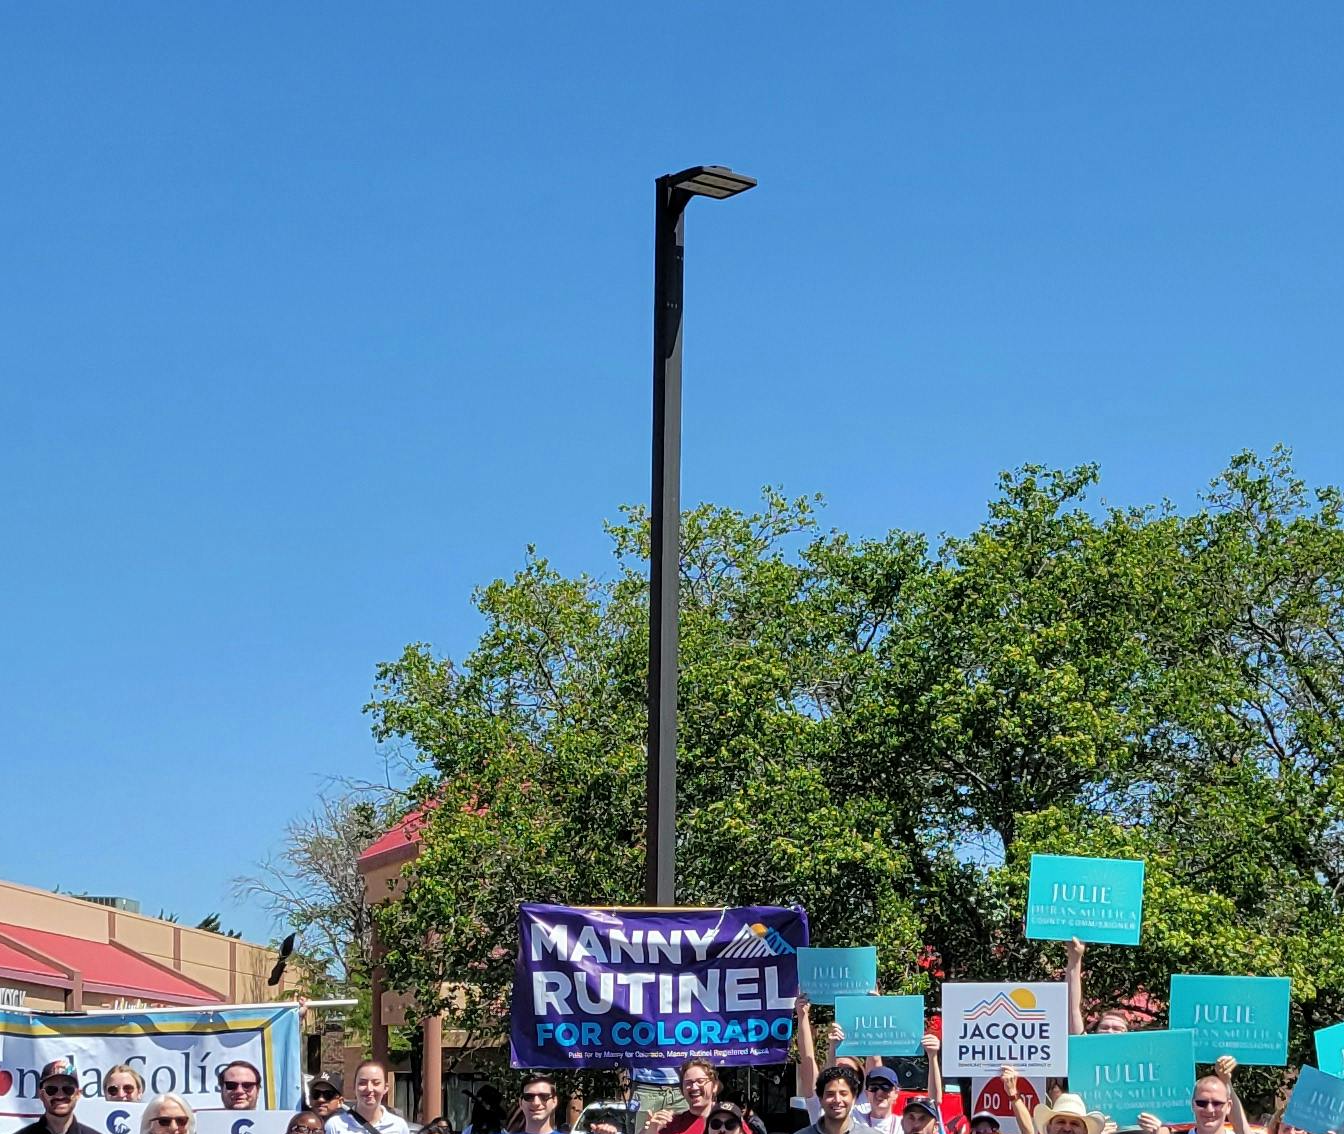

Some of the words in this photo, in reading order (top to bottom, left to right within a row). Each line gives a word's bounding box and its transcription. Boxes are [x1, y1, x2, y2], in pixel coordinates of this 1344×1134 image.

[1053, 883, 1111, 904] JULIE
[530, 922, 717, 966] MANNY
[532, 966, 797, 1016] RUTINEL
[855, 1016, 896, 1030] JULIE
[1194, 1004, 1255, 1024] JULIE
[536, 1022, 602, 1046] FOR
[611, 1018, 793, 1046] COLORADO
[959, 1023, 1050, 1044] JACQUE
[666, 1050, 688, 1059] Manny
[958, 1045, 1051, 1060] PHILLIPS
[1095, 1062, 1160, 1087] JULIE
[984, 1093, 1001, 1110] DO
